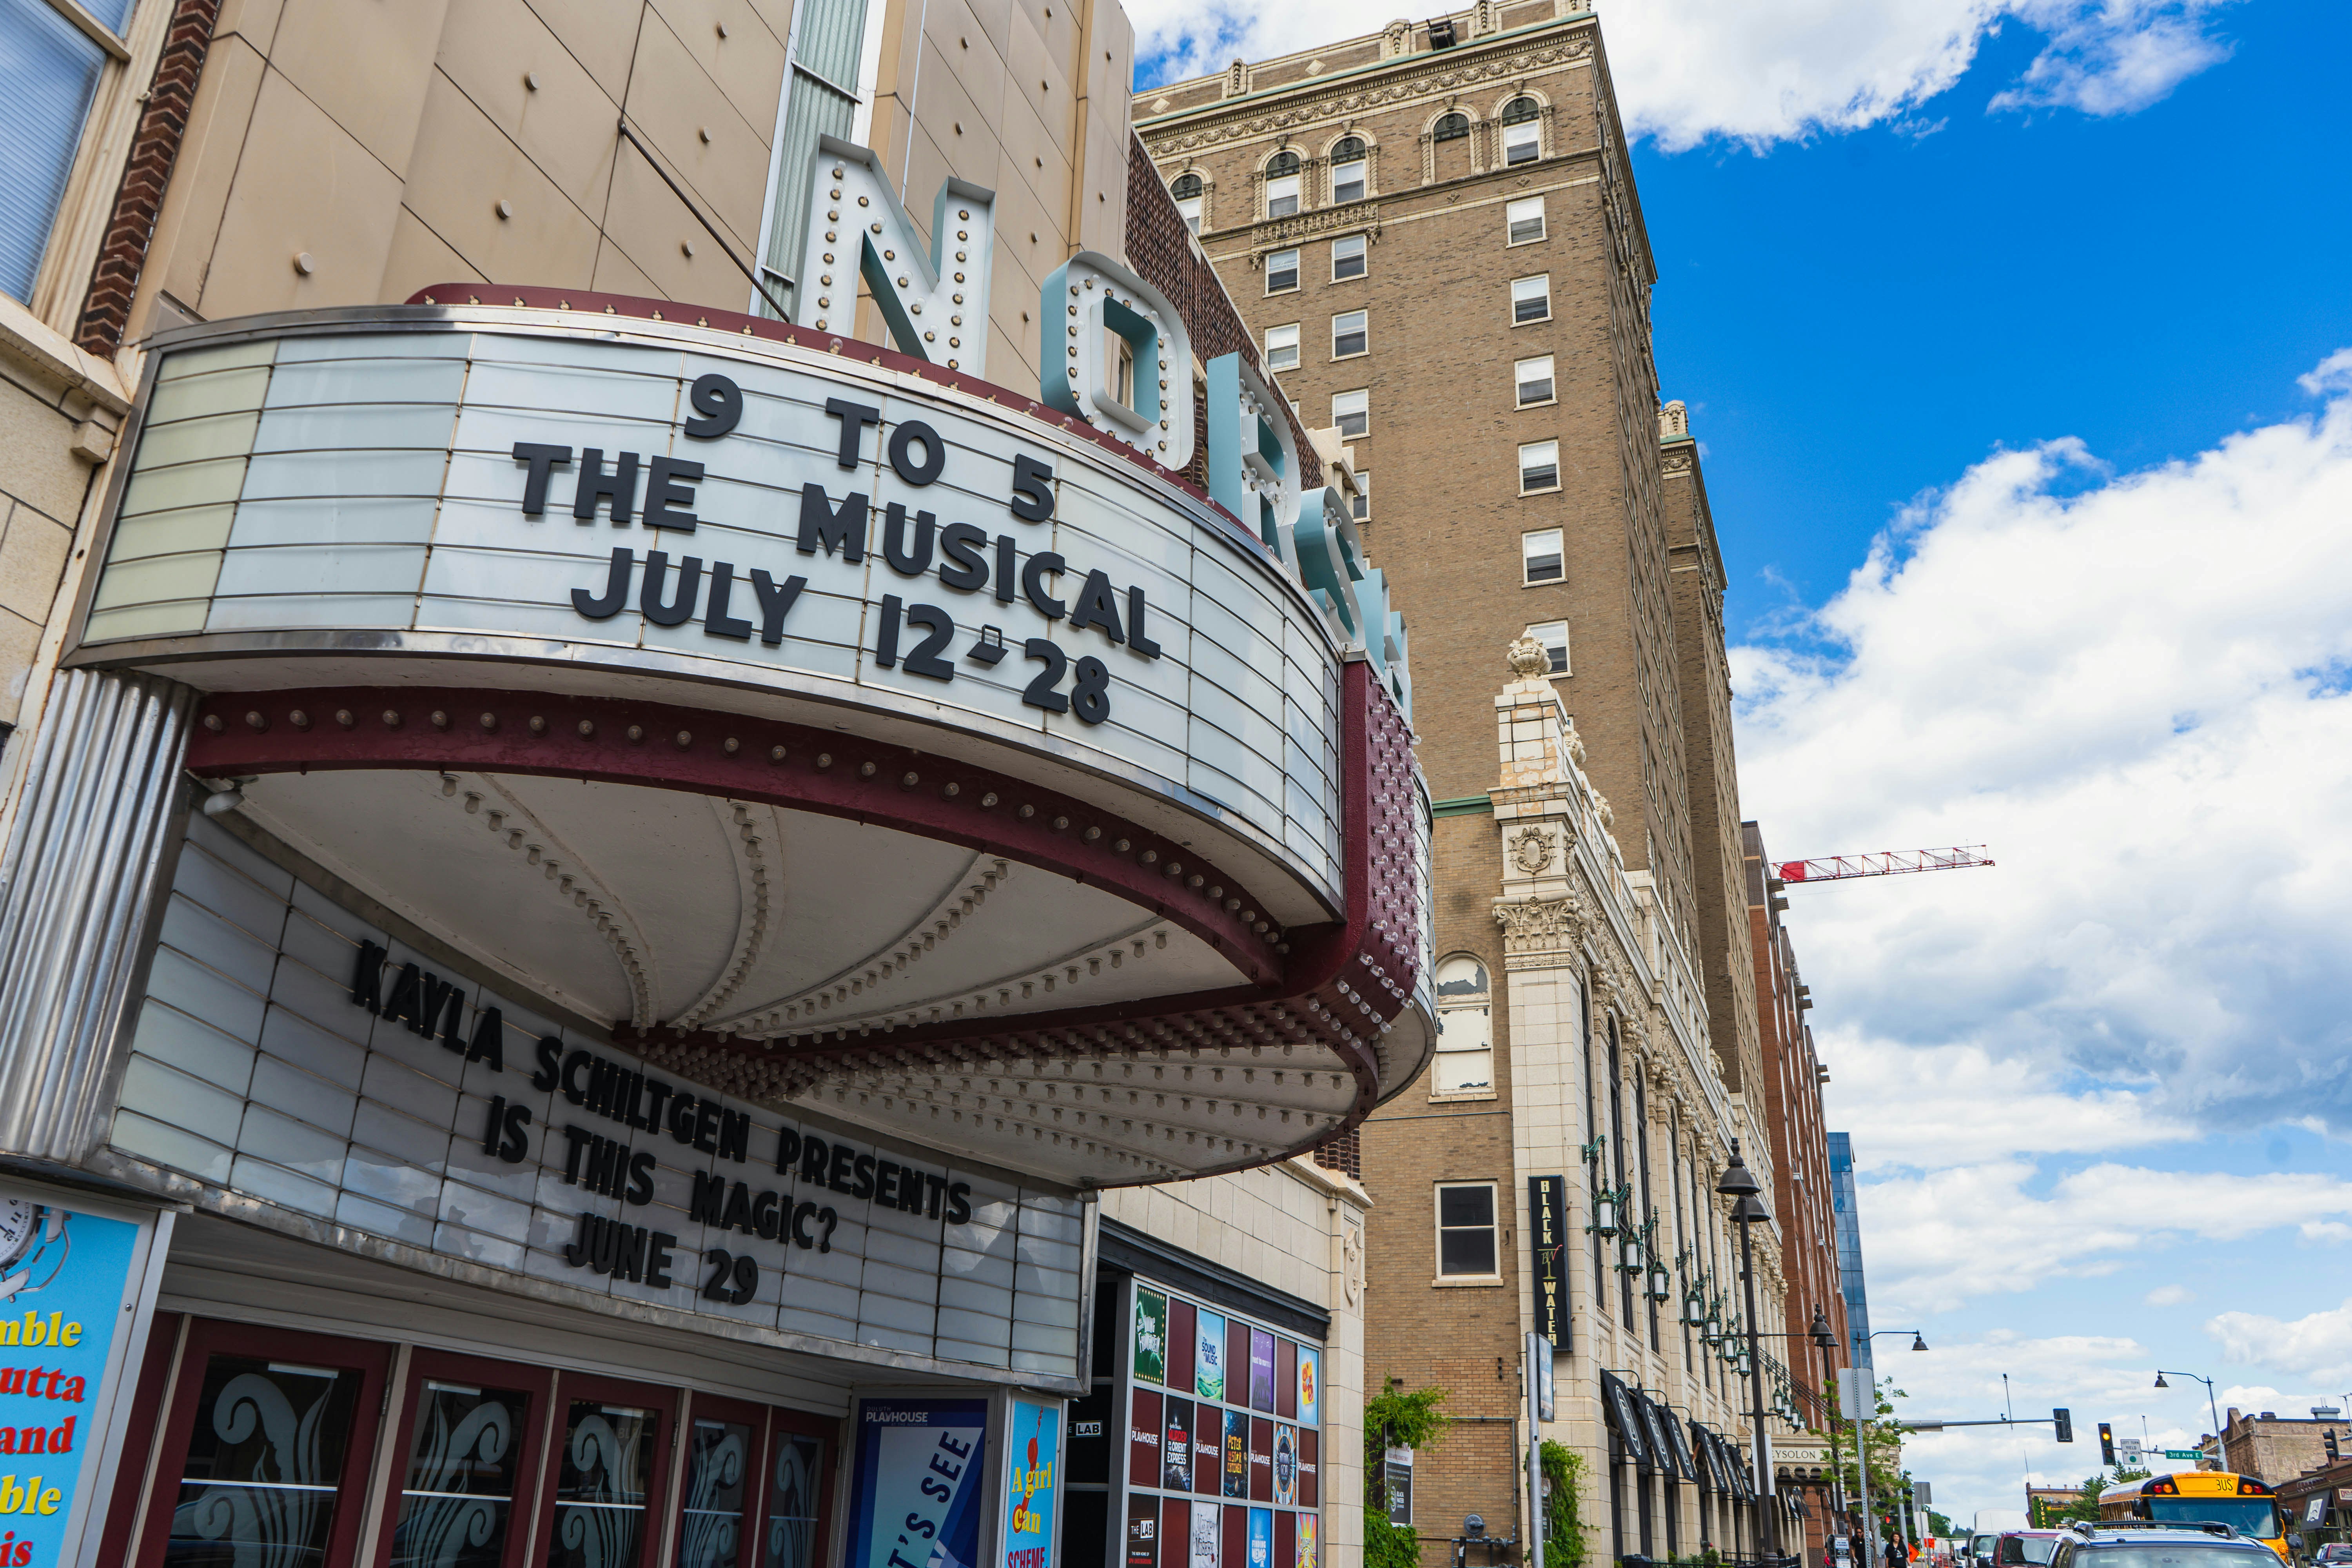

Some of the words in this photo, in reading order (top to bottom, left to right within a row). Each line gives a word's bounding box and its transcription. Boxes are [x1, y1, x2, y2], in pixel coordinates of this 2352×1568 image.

[684, 374, 743, 440] 9
[826, 397, 946, 486] TO
[1011, 454, 1054, 523] 5
[512, 442, 705, 532] THE
[797, 482, 1161, 659] MUSICAL
[571, 547, 808, 645] JULY
[352, 939, 504, 1073] KAYLA
[533, 1035, 751, 1164] SCHILTGEN
[777, 1127, 973, 1225] PRESENTS
[484, 1095, 533, 1164] IS
[564, 1124, 657, 1207] THIS
[690, 1170, 838, 1254] MAGIC?
[1541, 1180, 1552, 1244] BLACK
[565, 1212, 678, 1290] JUNE
[703, 1248, 760, 1306] 29
[1543, 1282, 1557, 1346] WATER
[1202, 1341, 1216, 1355] SOUND
[1205, 1354, 1218, 1366] MUSIC
[866, 1411, 929, 1422] PLAYHOUSE
[1078, 1424, 1100, 1434] LAB
[1168, 1428, 1187, 1442] MURDER
[1131, 1430, 1158, 1445] PLAYHOUSE
[1227, 1434, 1242, 1450] PETER
[1171, 1441, 1187, 1454] ORIENT
[1196, 1442, 1219, 1456] PLAYHOUSE
[1167, 1452, 1187, 1465] EXPRESS
[1251, 1452, 1270, 1465] PLAYHOUSE
[920, 1431, 971, 1503] SEE
[1298, 1461, 1316, 1473] PLAYHOUSE
[1011, 1467, 1023, 1493] A
[1025, 1461, 1052, 1499] girl
[2216, 1479, 2233, 1491] BUS
[1014, 1508, 1041, 1534] can
[1131, 1525, 1140, 1535] THE
[1141, 1523, 1153, 1536] LAB
[1007, 1546, 1048, 1568] SCHEME
